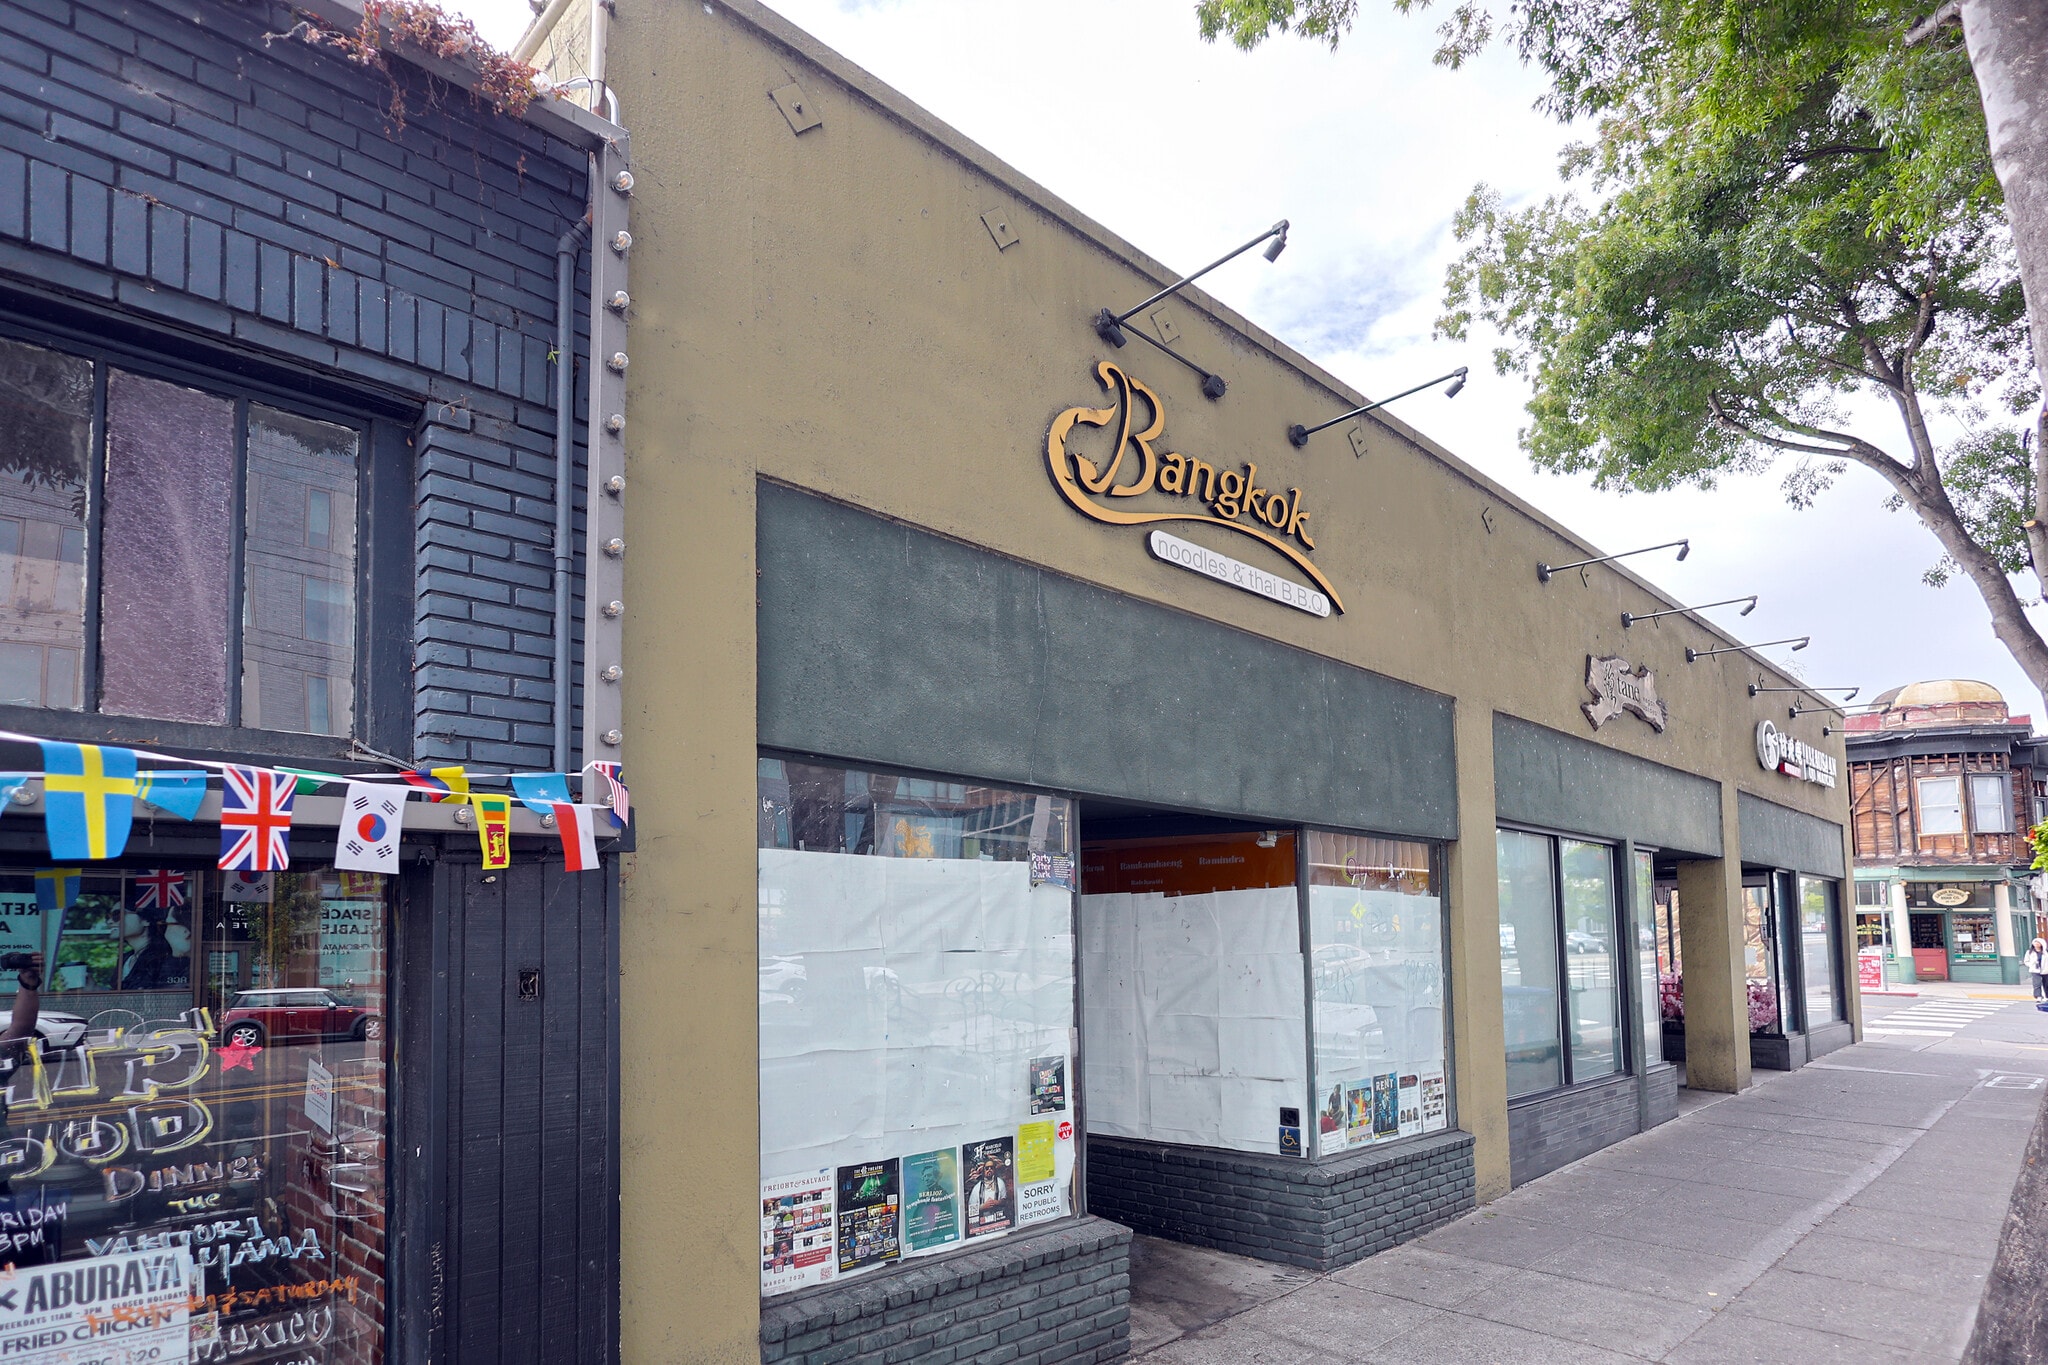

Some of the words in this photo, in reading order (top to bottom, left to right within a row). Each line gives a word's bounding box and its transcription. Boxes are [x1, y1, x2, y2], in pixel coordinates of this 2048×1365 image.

[1068, 361, 1315, 550] Bangkok
[1157, 536, 1228, 579] noodles
[1233, 563, 1245, 585] &
[1249, 569, 1277, 596] thai
[1617, 676, 1640, 701] tane
[1031, 852, 1052, 864] Party
[1032, 861, 1052, 870] After
[1032, 869, 1051, 878] Dark
[1375, 1078, 1394, 1092] RENT
[763, 1181, 794, 1193] FREIGHT
[801, 1175, 831, 1186] SALVAGE
[1024, 1183, 1055, 1199] SORRY
[1022, 1201, 1032, 1210] NO
[1033, 1196, 1057, 1208] PUBLIC
[1019, 1204, 1061, 1221] RESTROOMS
[24, 1252, 183, 1315] ABURAYA
[111, 1298, 144, 1311] CLOSED
[147, 1291, 188, 1304] HOLIDAYS
[2, 1329, 68, 1355] FRIED
[72, 1308, 173, 1341] CHICKEN
